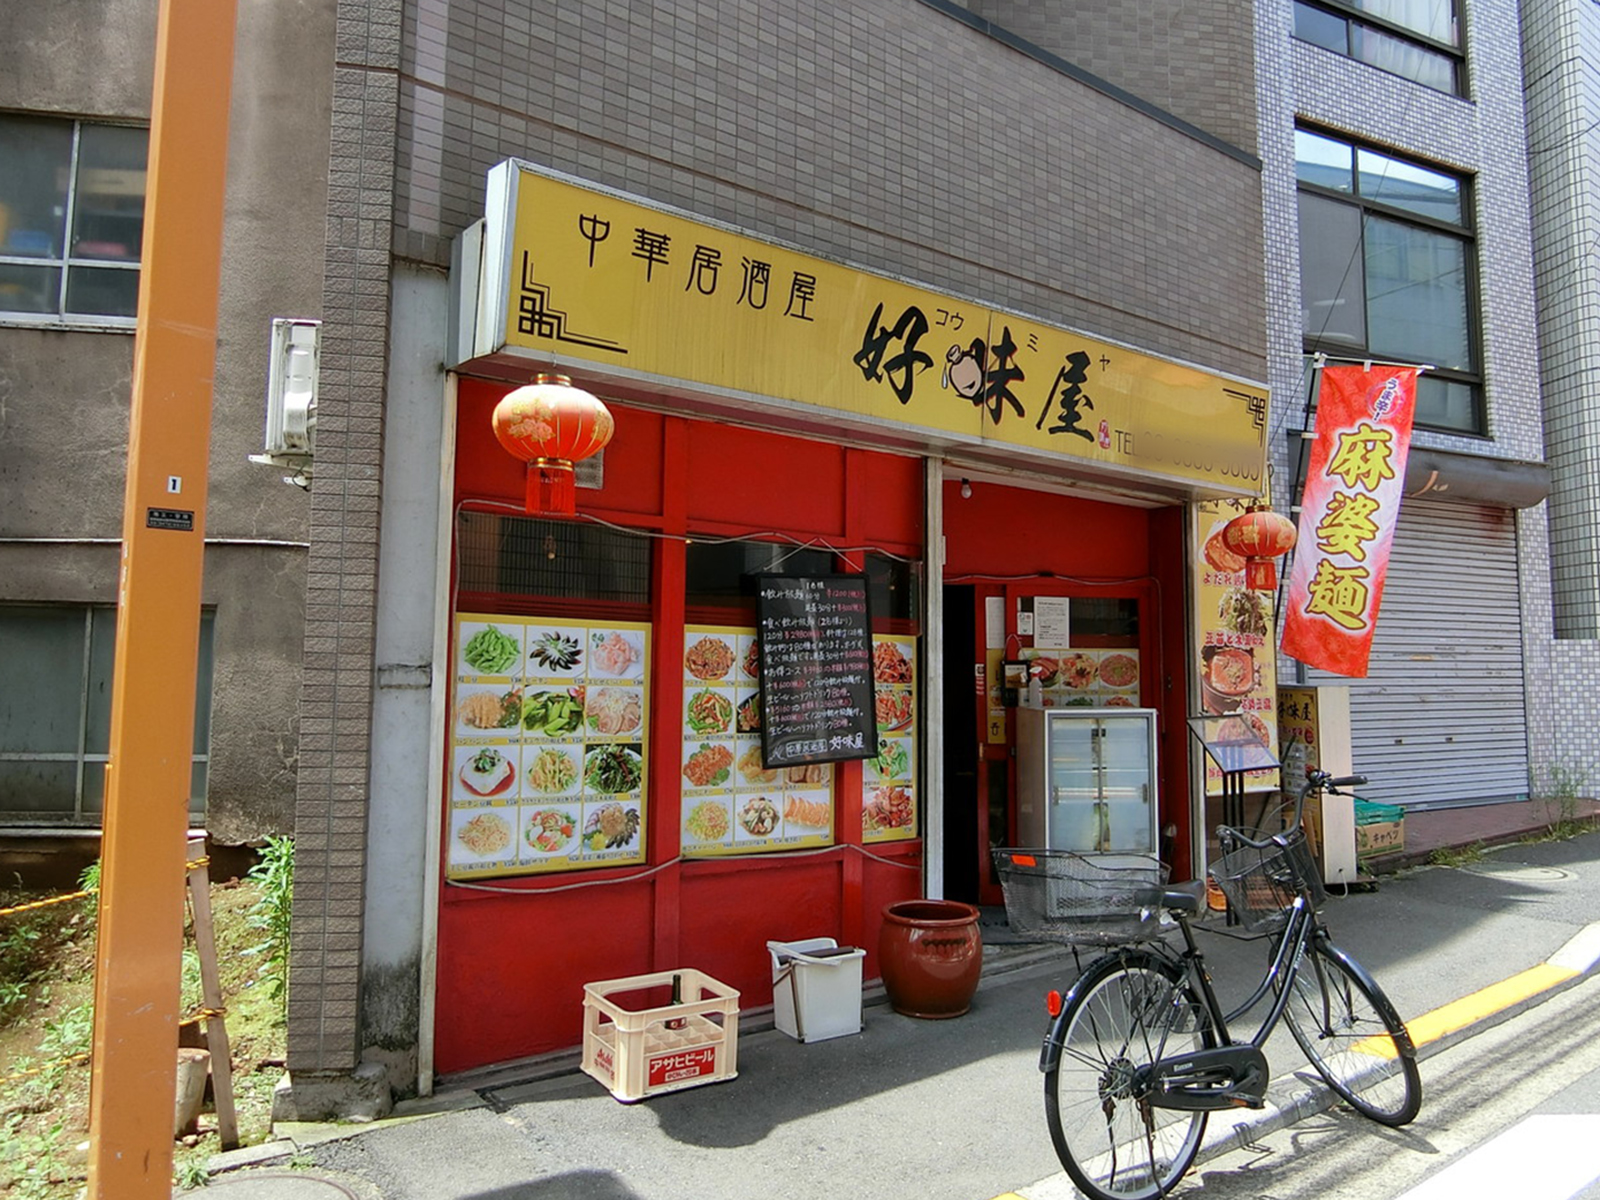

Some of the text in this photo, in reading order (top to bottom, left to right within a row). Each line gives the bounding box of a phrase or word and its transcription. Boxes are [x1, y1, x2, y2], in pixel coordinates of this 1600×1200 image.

[578, 213, 817, 322] 中華居酒屋
[935, 308, 964, 331] コウ
[853, 302, 1096, 442] 好味屋
[171, 478, 178, 491] 1
[1305, 423, 1395, 630] 麻婆麺
[650, 1049, 715, 1074] アサヒビール
